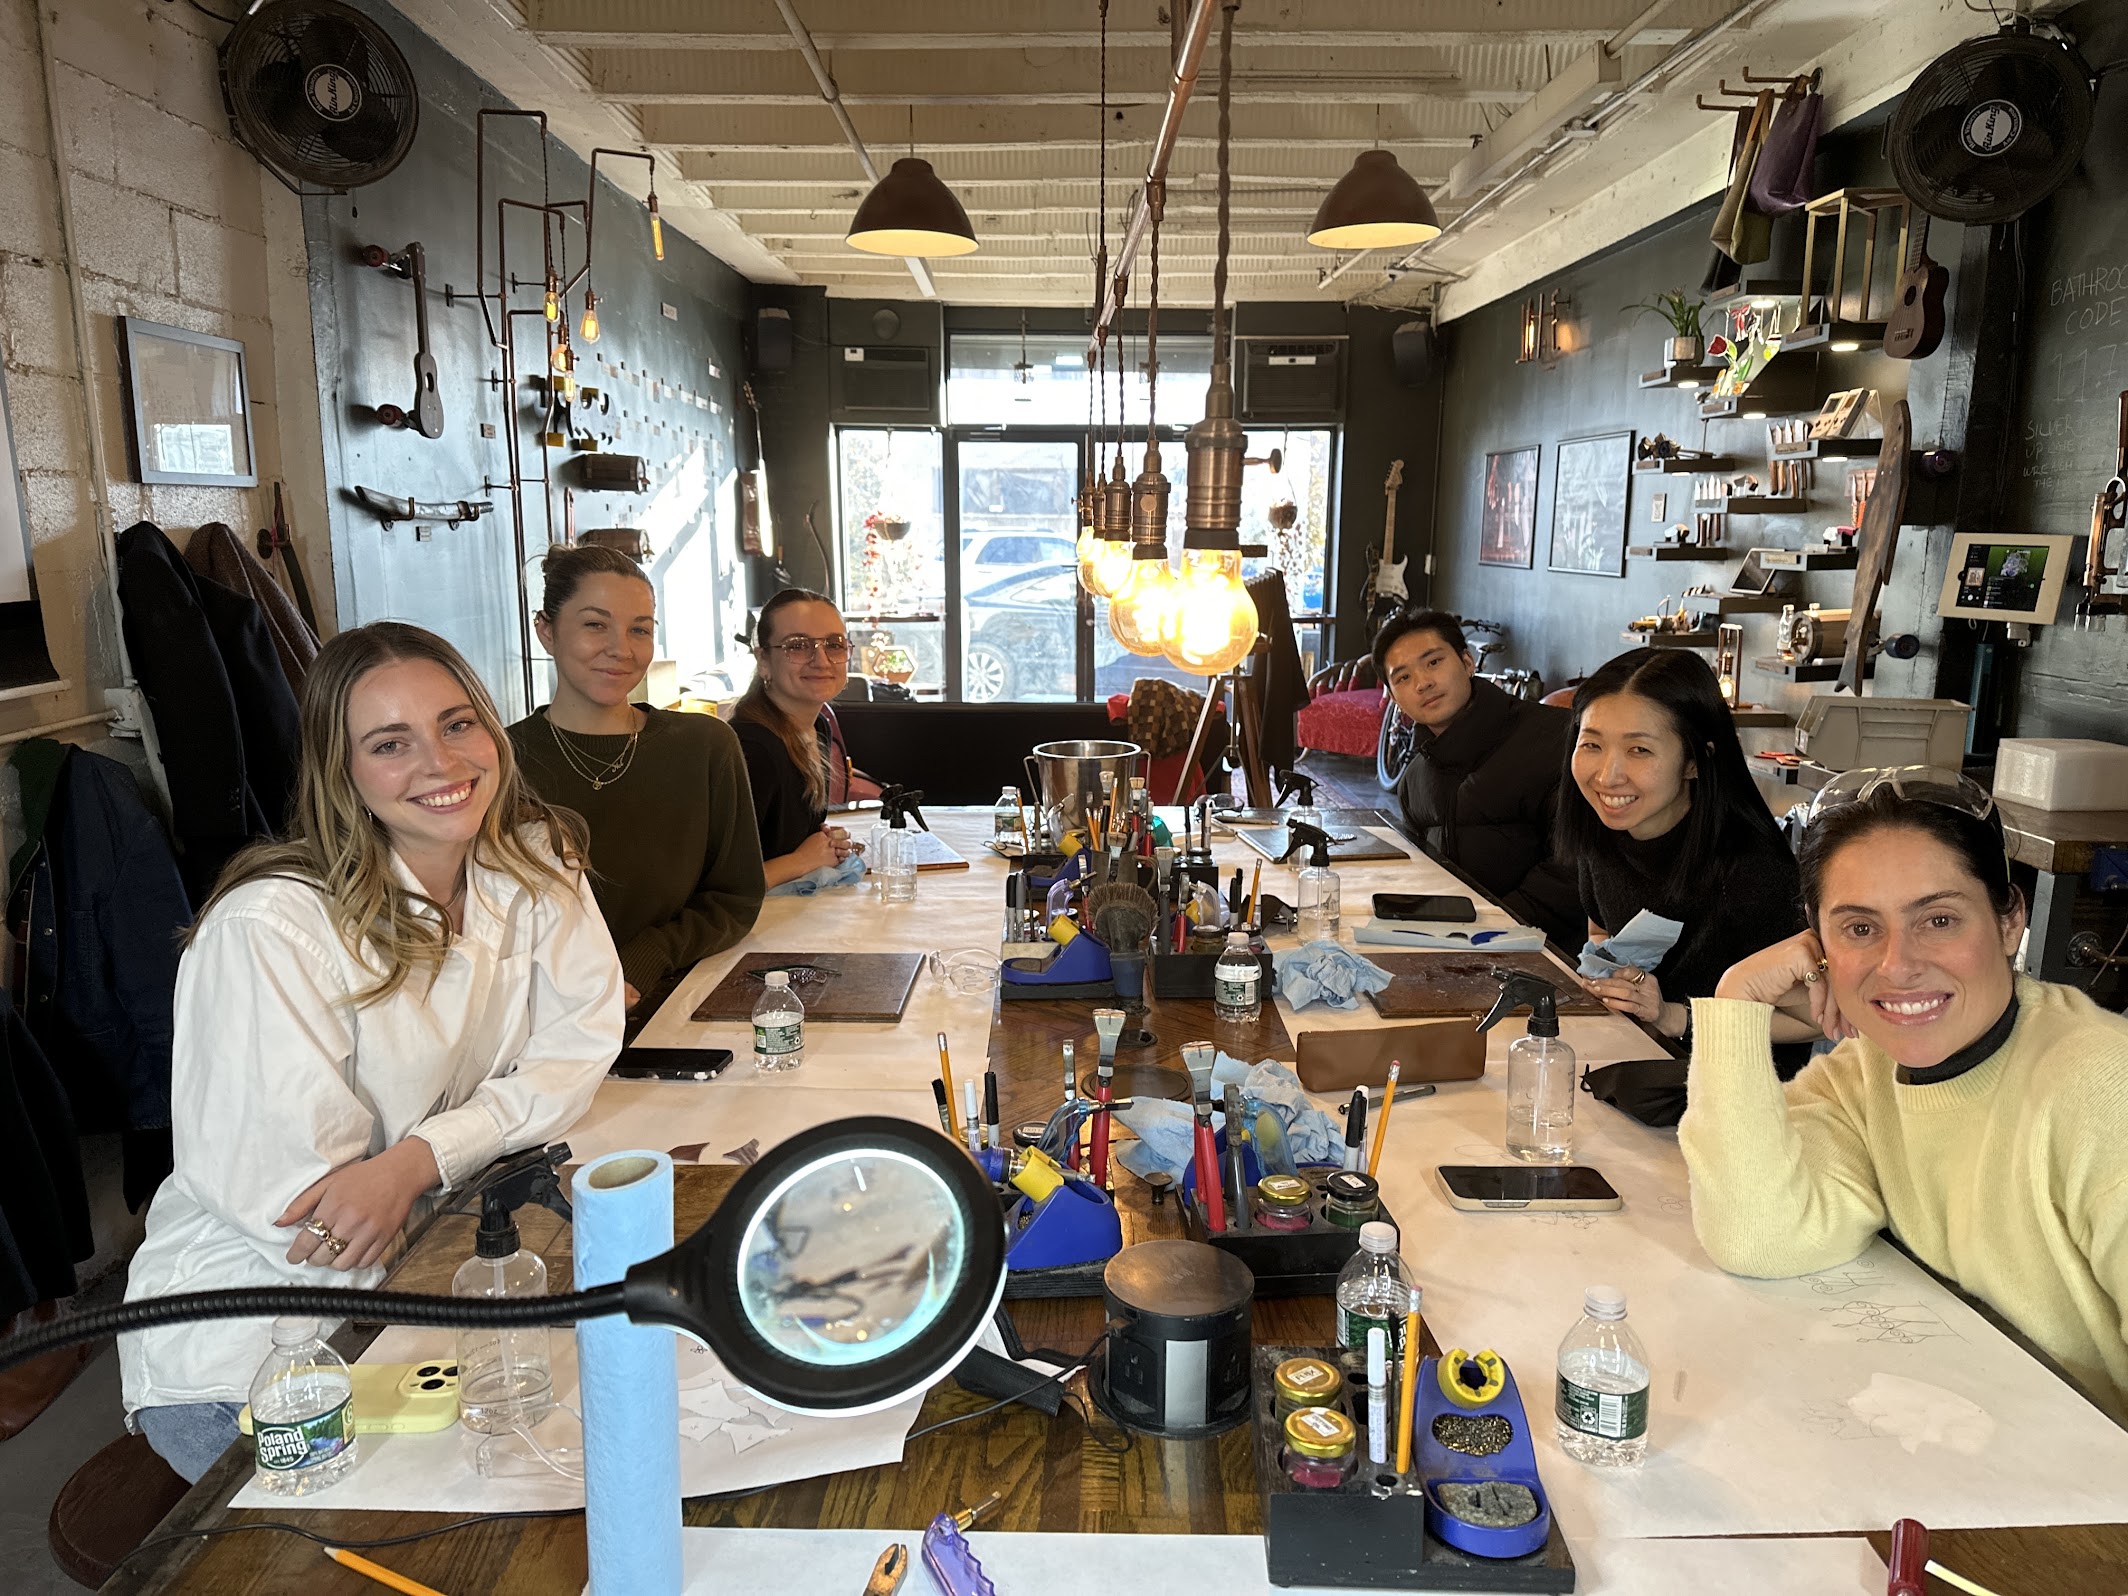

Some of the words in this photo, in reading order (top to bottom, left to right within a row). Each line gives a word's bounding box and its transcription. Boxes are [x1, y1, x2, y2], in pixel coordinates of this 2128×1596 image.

[2064, 296, 2127, 335] CODE
[2025, 441, 2044, 460] UP
[480, 1407, 499, 1415] 12oz
[256, 1426, 305, 1447] Poland
[259, 1440, 309, 1463] Spring
